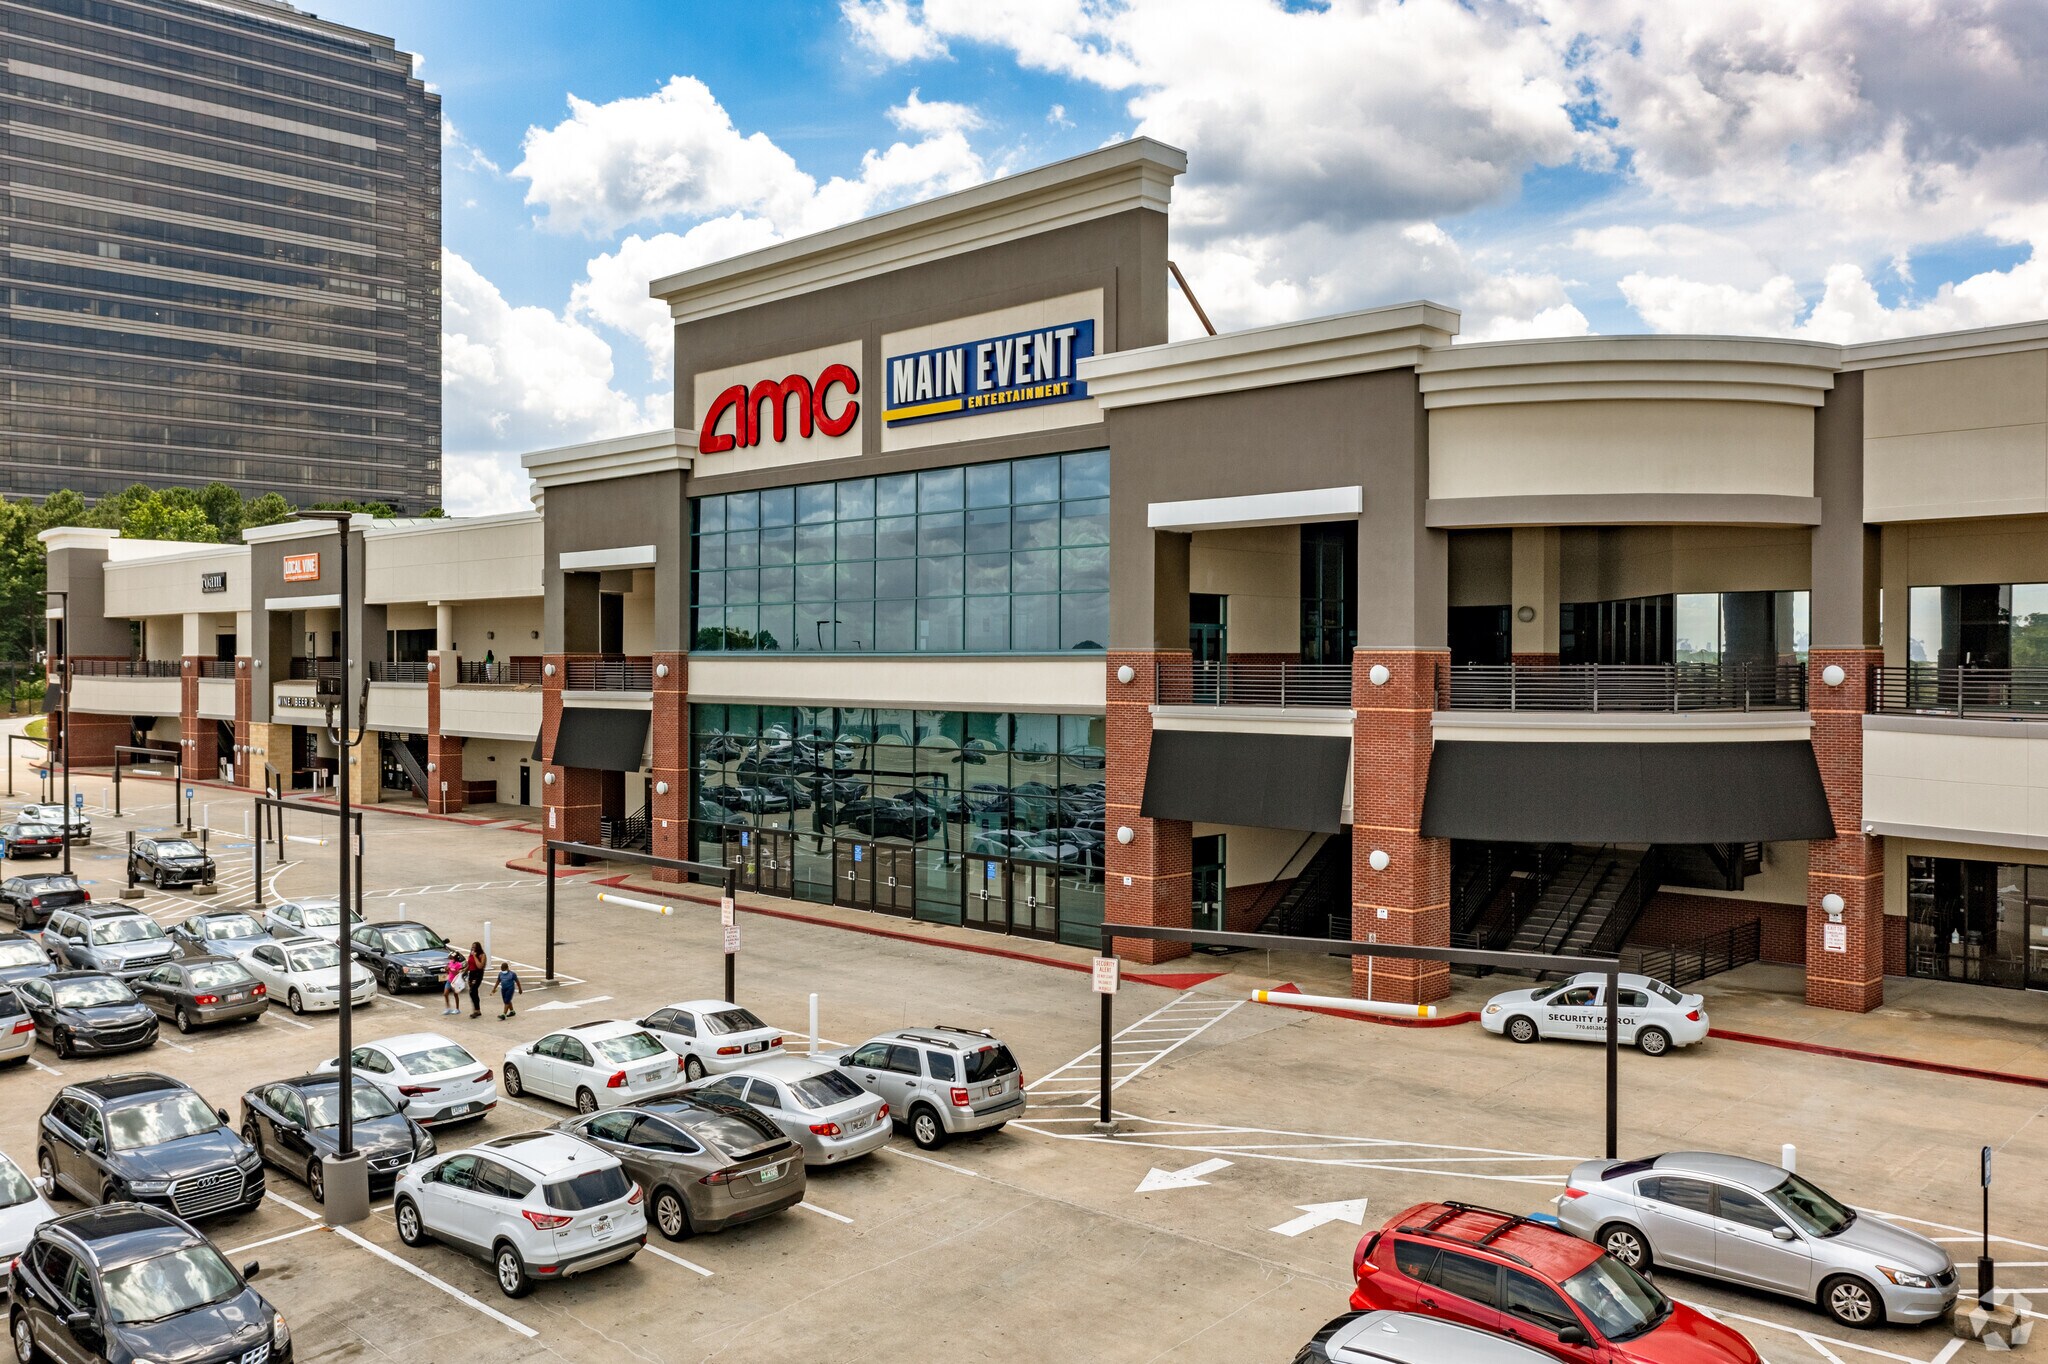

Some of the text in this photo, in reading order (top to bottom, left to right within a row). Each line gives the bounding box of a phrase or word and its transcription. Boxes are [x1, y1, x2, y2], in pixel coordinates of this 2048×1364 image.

[893, 327, 1079, 404] MAIN EVENT
[967, 382, 1069, 408] ENTERTAINMENT
[285, 558, 315, 574] LOCAL VINE
[294, 697, 309, 707] BEER
[1548, 1013, 1636, 1025] SECURITY PAROL
